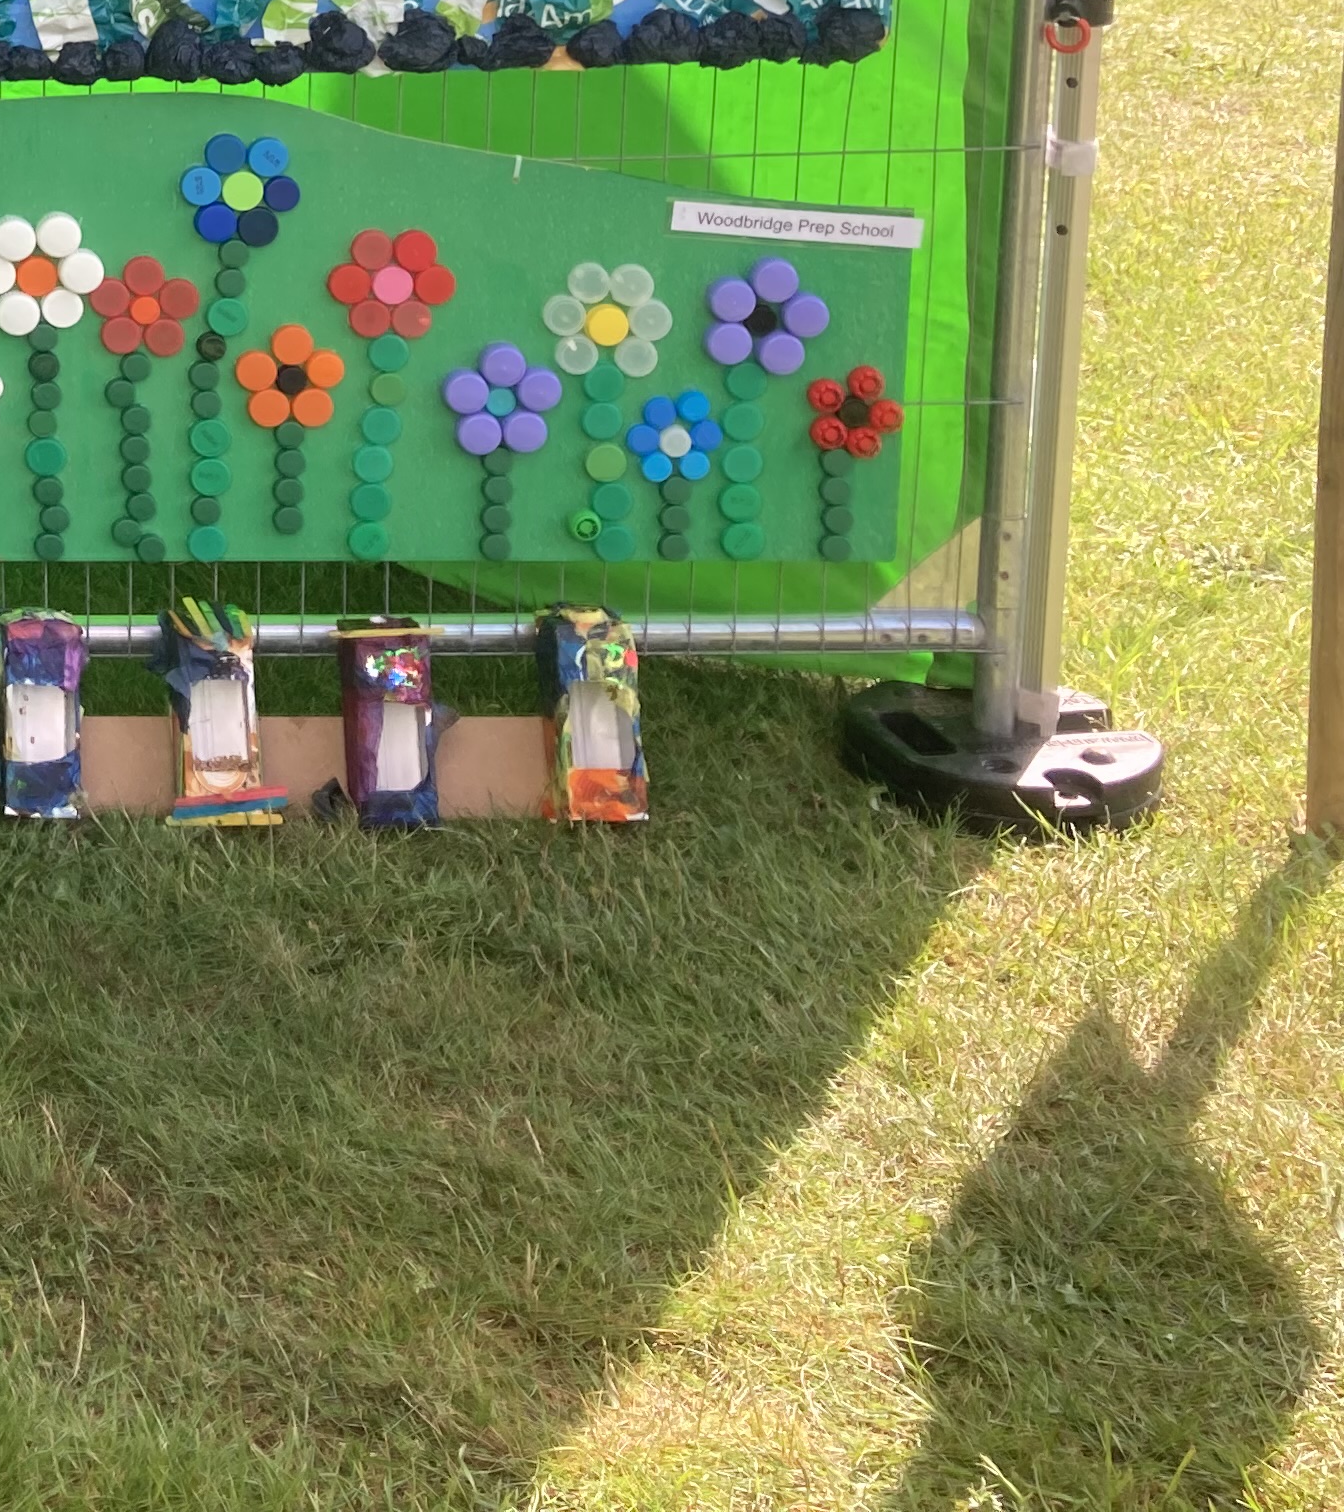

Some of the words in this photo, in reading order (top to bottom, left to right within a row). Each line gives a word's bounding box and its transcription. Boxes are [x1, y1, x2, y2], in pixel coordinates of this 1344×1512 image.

[697, 210, 793, 234] Woodbridge
[798, 218, 836, 236] Prep
[840, 221, 895, 239] School
